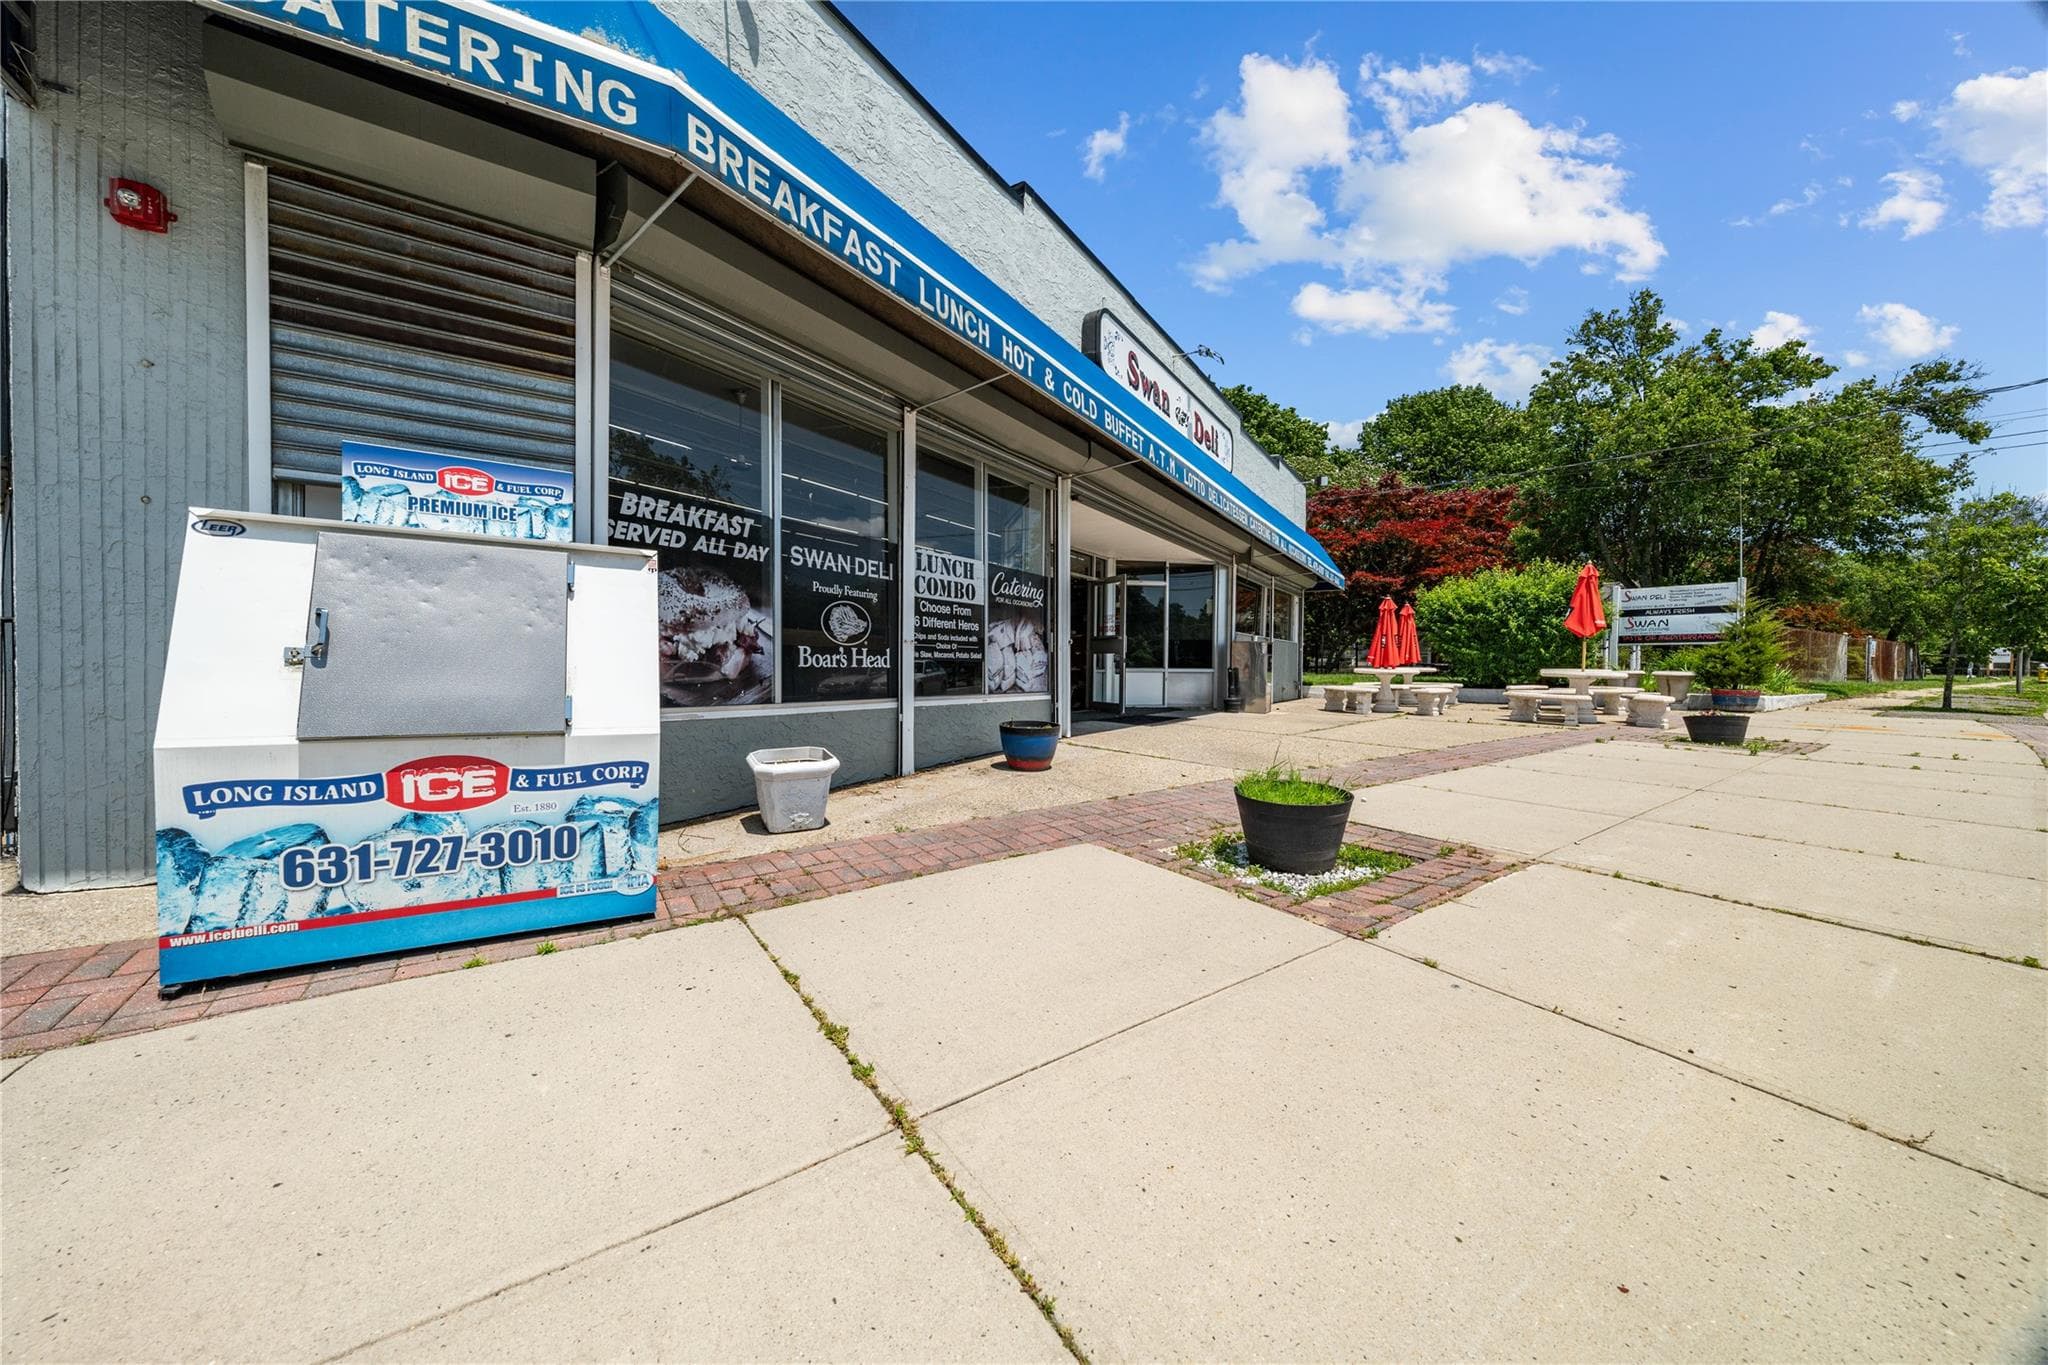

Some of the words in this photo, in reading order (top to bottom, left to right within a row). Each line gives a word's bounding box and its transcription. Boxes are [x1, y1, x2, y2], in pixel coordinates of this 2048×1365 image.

[688, 112, 902, 287] BREAKFAST
[919, 276, 990, 348] LUNCH
[1002, 335, 1035, 377] HOT
[1045, 367, 1055, 391] &
[1063, 381, 1098, 420] COLD
[1104, 410, 1145, 453] BUFFET
[1149, 446, 1180, 480] A.T.M.
[1183, 468, 1206, 497] LOTTO
[1208, 487, 1249, 526] DELICATESSEN
[1127, 350, 1171, 418] Swan
[1193, 411, 1220, 458] Deli
[356, 464, 390, 476] LONG
[393, 469, 435, 482] ISLAND
[444, 470, 489, 492] ICE
[496, 482, 505, 491] &
[507, 484, 531, 495] FUEL
[534, 485, 563, 498] CORP.
[407, 496, 488, 520] PREMIUM
[491, 505, 518, 522] ICE
[619, 491, 755, 538] BREAKFAST
[692, 535, 727, 558] ALL
[733, 542, 770, 563] DAY
[790, 545, 851, 575] SWAN
[854, 557, 894, 581] DELI
[914, 552, 975, 580] LUNCH
[812, 581, 843, 598] Proudly
[844, 585, 879, 603] Featuring
[914, 575, 976, 601] COMBO
[991, 571, 1044, 608] Catering
[1621, 590, 1647, 603] SWAN
[920, 600, 951, 615] Choose
[953, 604, 972, 617] From
[1645, 608, 1672, 616] ALWAYS
[1673, 606, 1695, 614] FRESH
[914, 615, 921, 627] 6
[922, 616, 957, 630] Different
[958, 620, 980, 632] Heros
[1624, 616, 1669, 630] SWAN
[798, 645, 848, 669] Boar's
[850, 646, 891, 669] Head
[935, 642, 951, 650] Choice
[400, 764, 498, 804] ICE
[515, 774, 530, 788] &
[536, 770, 587, 788] FUEL
[592, 765, 645, 782] CORP.
[192, 785, 273, 807] LONG
[283, 780, 378, 801] ISLAND
[513, 803, 531, 814] Est.
[534, 802, 558, 813] 1880
[281, 824, 579, 890] 631-727-3010
[169, 921, 300, 949] www.icefuelli.com
